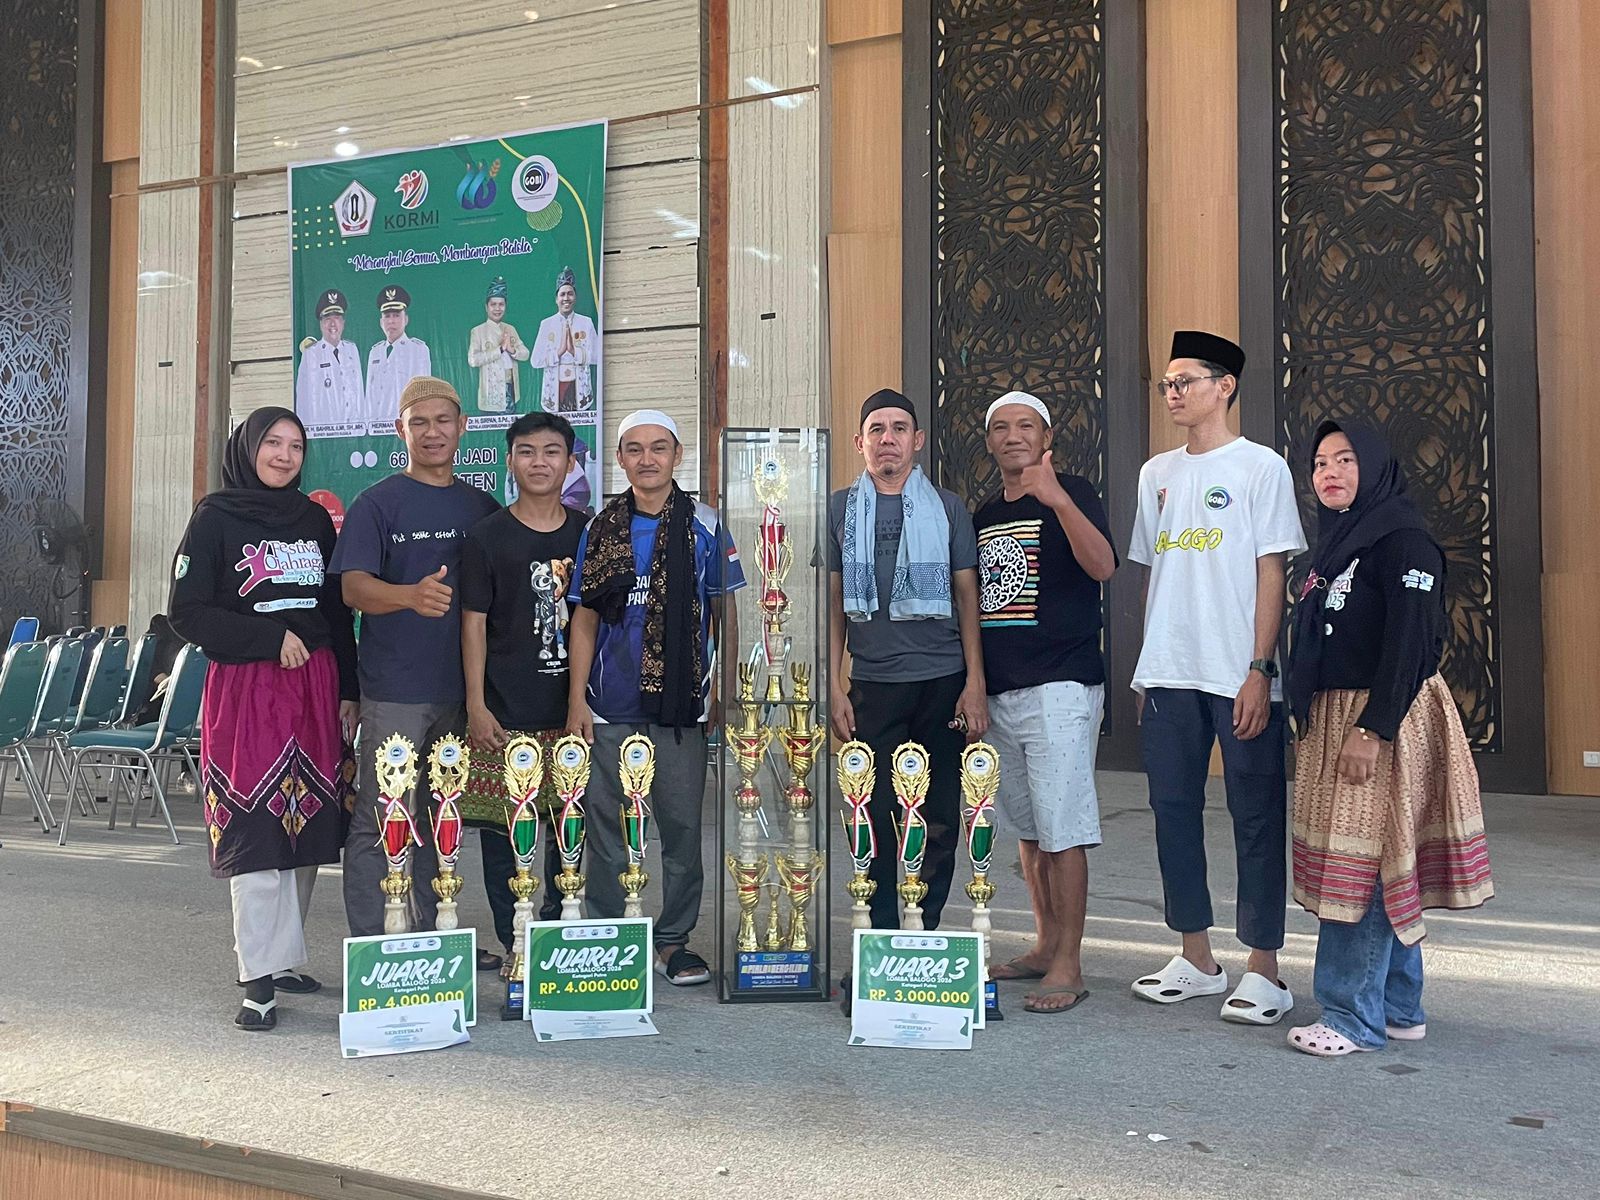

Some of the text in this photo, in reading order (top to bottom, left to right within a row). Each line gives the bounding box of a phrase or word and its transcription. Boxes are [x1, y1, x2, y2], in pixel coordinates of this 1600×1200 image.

[384, 209, 439, 230] KORMI
[440, 243, 500, 264] Membangun
[463, 447, 497, 465] JADI
[540, 944, 640, 971] JUARA 2
[869, 955, 970, 980] JUARA 3
[361, 955, 463, 986] JUARA 1
[377, 982, 401, 990] LOMBA
[401, 979, 430, 987] BALOGO
[539, 978, 639, 995] RP. 4.000.000
[359, 990, 465, 1011] RP. 4.000.000
[869, 988, 891, 1002] RP.
[894, 989, 970, 1004] 3.000.000
[384, 1028, 424, 1036] SERTIFIKAT
